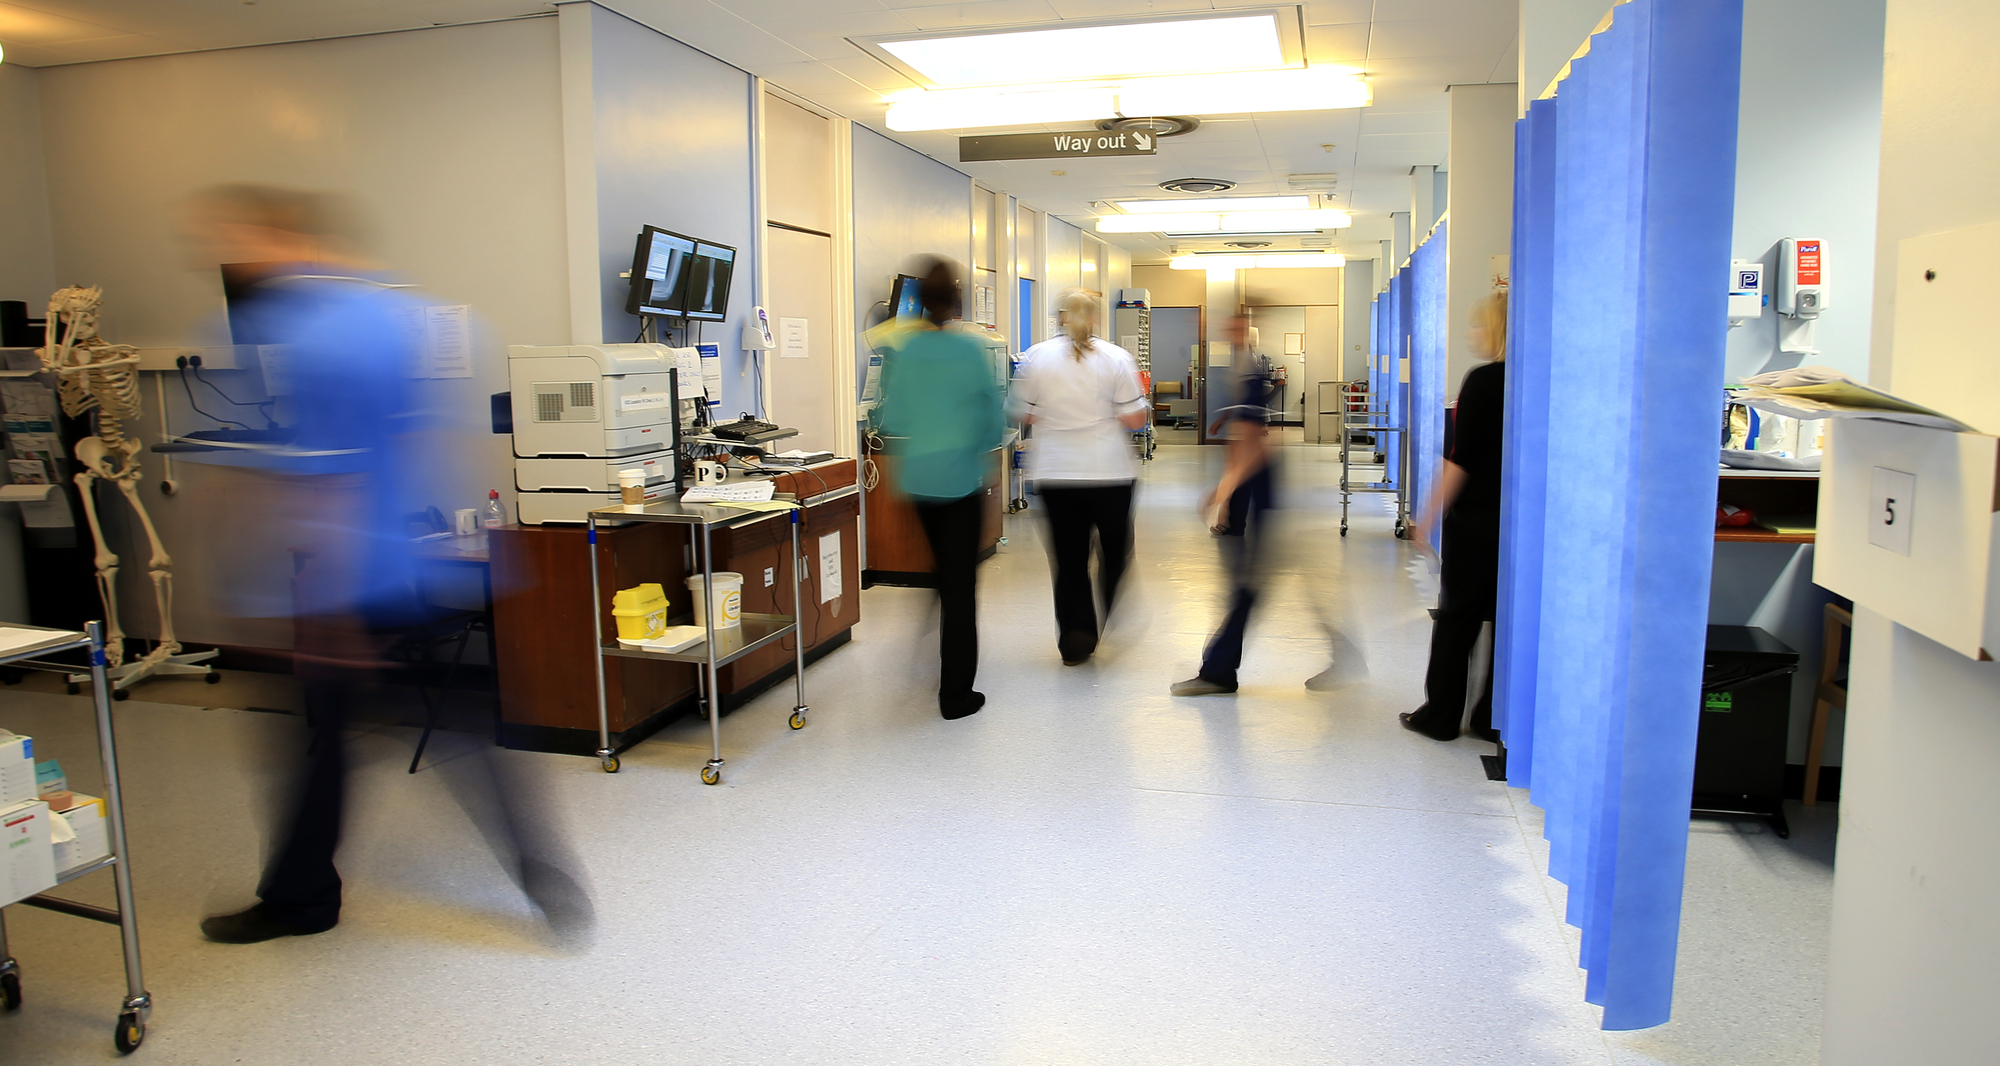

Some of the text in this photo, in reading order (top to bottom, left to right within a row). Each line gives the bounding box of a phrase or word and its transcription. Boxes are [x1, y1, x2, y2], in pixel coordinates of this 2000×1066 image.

[1053, 133, 1127, 153] Way out
[698, 467, 710, 481] P
[1884, 497, 1896, 525] 5
